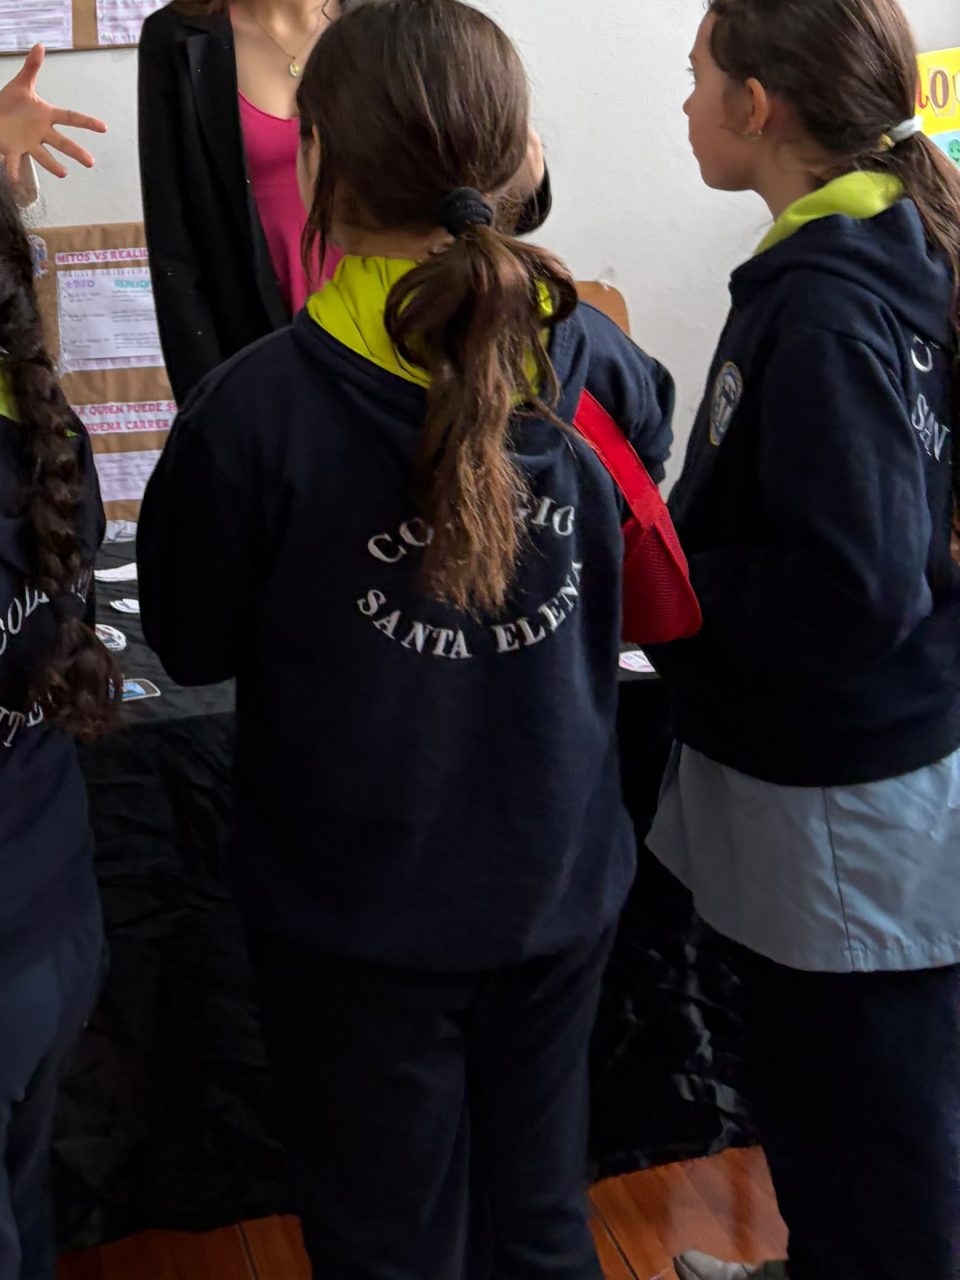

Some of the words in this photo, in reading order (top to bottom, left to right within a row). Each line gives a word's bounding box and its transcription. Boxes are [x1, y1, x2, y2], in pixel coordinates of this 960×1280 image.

[57, 252, 91, 263] MITOS
[94, 251, 109, 261] VS
[357, 588, 474, 660] SANTA
